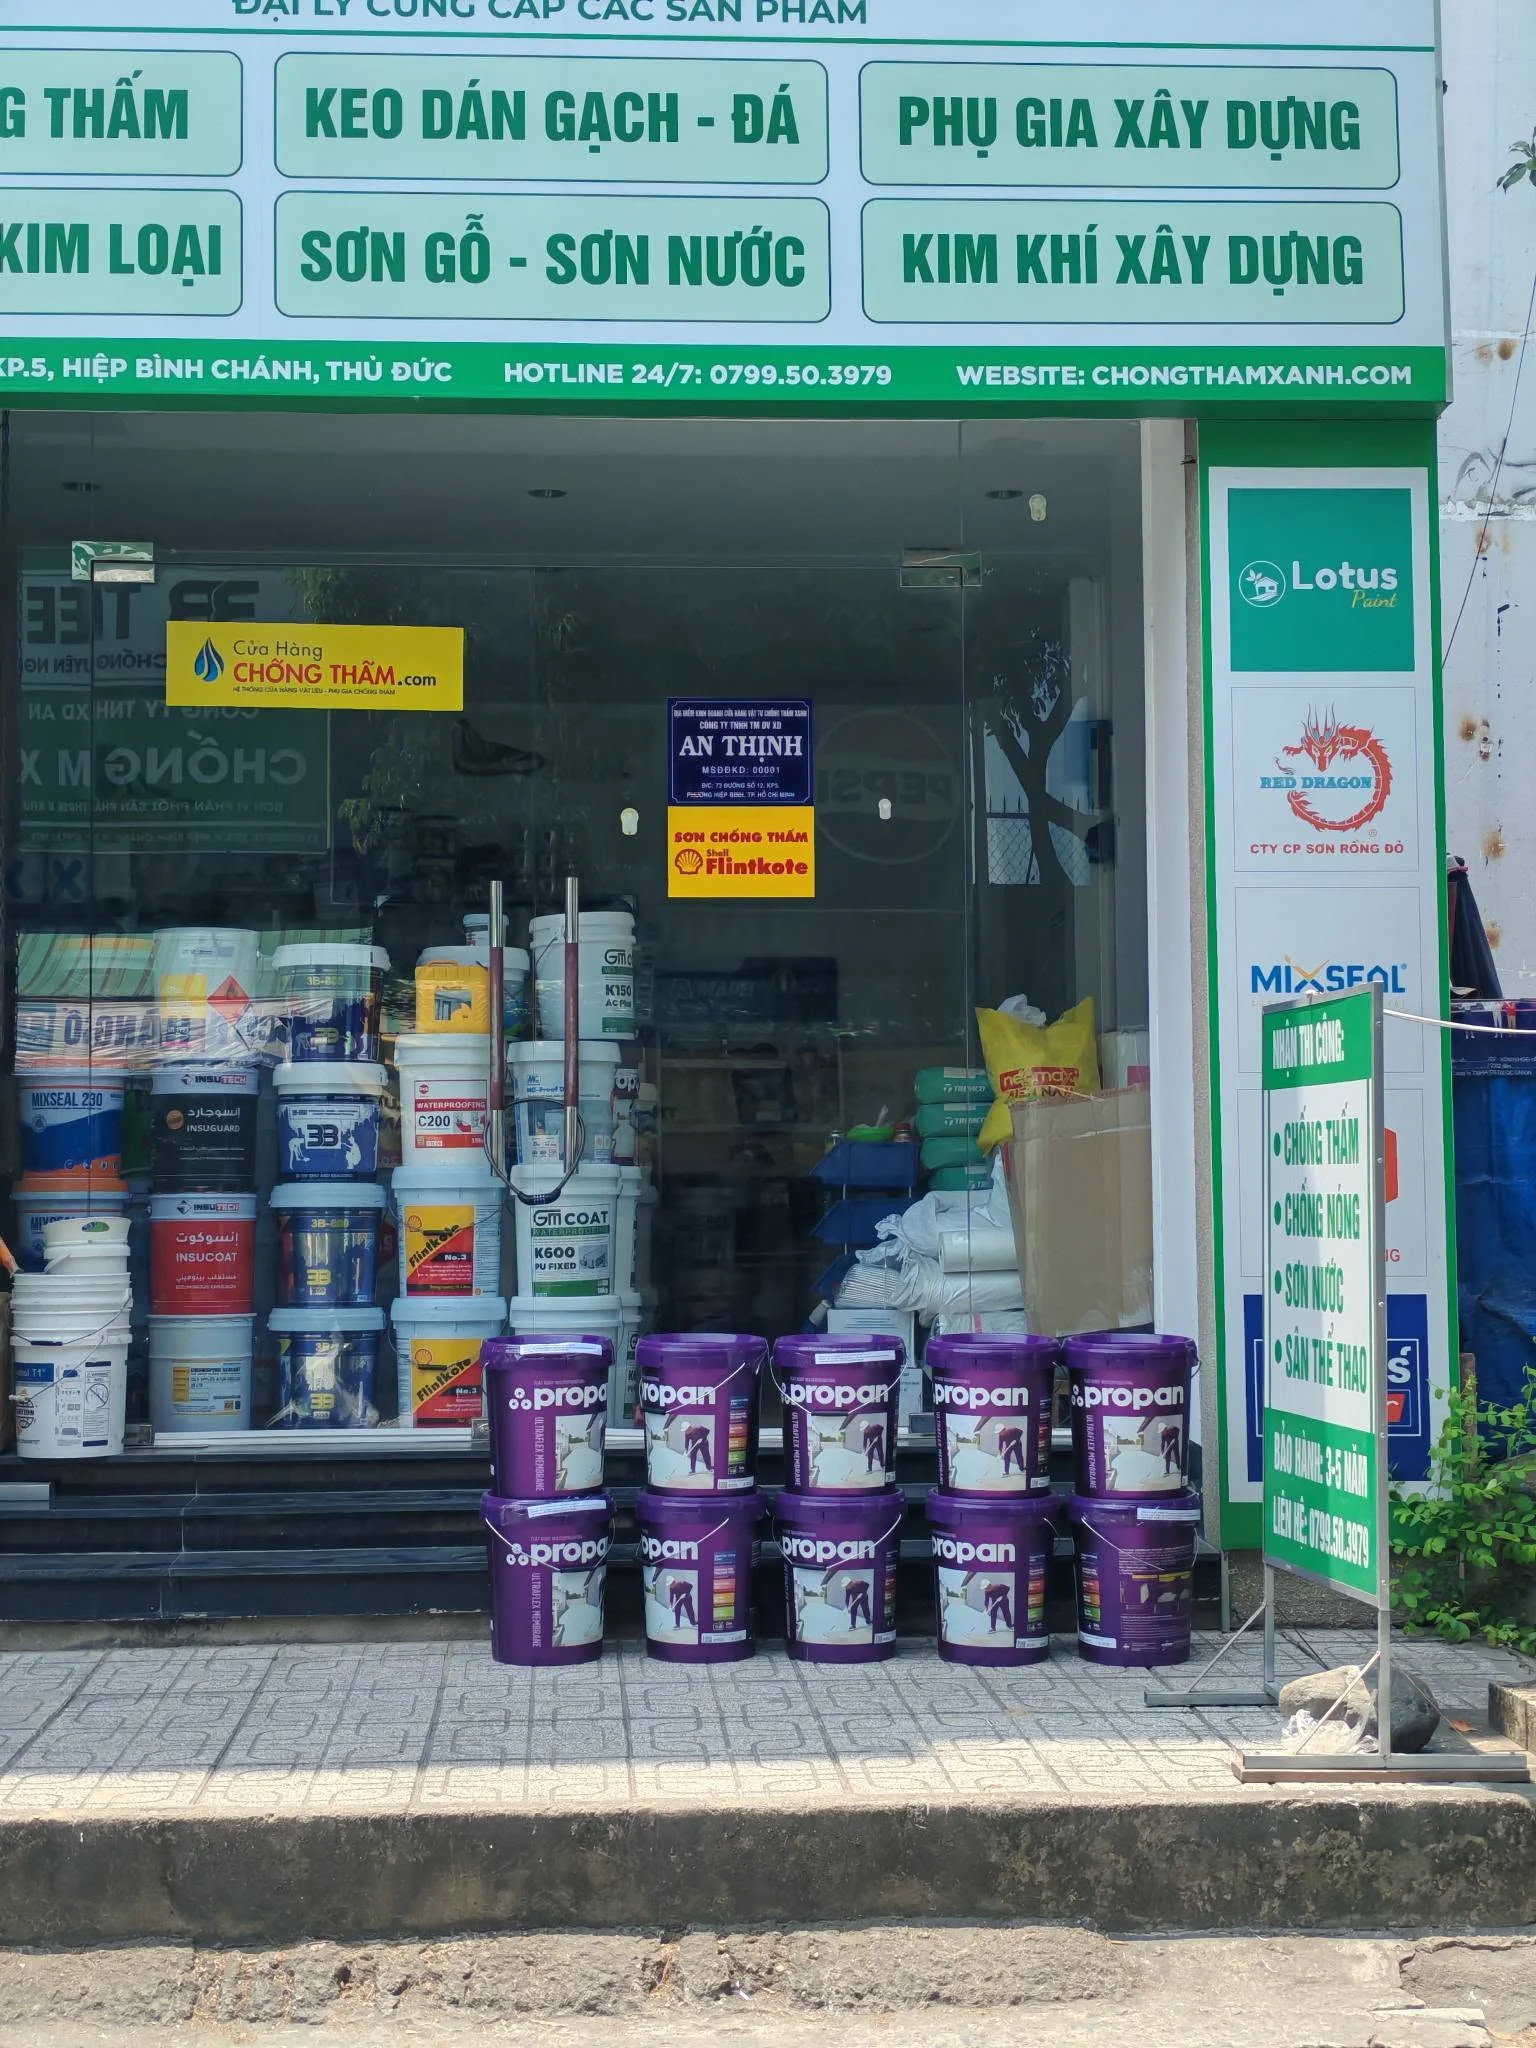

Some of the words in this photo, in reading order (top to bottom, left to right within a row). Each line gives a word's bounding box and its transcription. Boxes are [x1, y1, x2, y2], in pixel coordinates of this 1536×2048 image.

[43, 69, 189, 140] THẤM
[306, 87, 403, 140] KEO
[422, 78, 534, 142] DÁN
[544, 90, 680, 154] GẠCH
[731, 83, 800, 145] ĐÁ
[898, 96, 998, 159] PHỤ
[1015, 98, 1098, 150] GIA
[1114, 88, 1210, 151] XÂY
[1227, 95, 1361, 162] DỰNG
[109, 223, 222, 287] LOẠI
[300, 228, 406, 284] SƠN
[424, 213, 491, 285] GỖ
[545, 229, 649, 286] SƠN
[668, 224, 806, 289] NƯỚC
[902, 233, 998, 285] KIM
[1016, 223, 1099, 285] KHÍ
[1115, 223, 1211, 286] XÂY
[1228, 230, 1364, 296] DỰNG
[63, 353, 128, 384] HIỆP
[136, 354, 204, 380] BÌNH
[211, 354, 319, 384] CHÁNH,
[325, 354, 384, 381] THỦ
[391, 356, 453, 383] ĐỨC
[504, 362, 624, 384] HOTLINE
[631, 363, 702, 388] 24/7:
[709, 363, 892, 386] 0799.50.3979
[956, 365, 1086, 387] WEBSITE:
[1092, 365, 1413, 387] CHONGTHAMXANH.COM
[1293, 560, 1398, 591] Lotus
[1351, 589, 1399, 609] Paint
[232, 639, 270, 657] Cửa
[276, 639, 323, 661] Hàng
[232, 658, 323, 685] CHỐNG
[720, 720, 729, 730] TY
[730, 720, 748, 730] TNHH
[750, 720, 760, 730] TM
[678, 735, 714, 757] AN
[721, 735, 803, 763] THỊNH
[1260, 775, 1297, 790] RED
[1300, 775, 1372, 790] DRAGON
[674, 831, 705, 843] SƠN
[709, 828, 763, 843] CHỐNG
[767, 828, 809, 843] THẤM
[1250, 843, 1277, 854] CTY
[1282, 843, 1301, 854] CP
[1306, 842, 1335, 855] SƠN
[1339, 839, 1380, 854] RỒNG
[706, 848, 729, 857] Shell
[706, 856, 809, 875] Flintkote
[1273, 1018, 1297, 1078] NHẬN
[1299, 1022, 1314, 1066] THI
[1315, 1011, 1344, 1065] CÔNG:
[32, 1092, 78, 1107] MIXSEAL
[417, 1101, 486, 1109] WATERPROOFING
[186, 1124, 241, 1133] INSUGUARD
[418, 1115, 451, 1128] C200
[1284, 1106, 1323, 1166] CHỐNG
[1326, 1102, 1360, 1165] THẤM
[306, 1124, 339, 1147] 3B
[564, 1210, 609, 1226] COAT
[1285, 1177, 1323, 1238] CHỐNG
[1327, 1184, 1360, 1240] NÓNG
[175, 1252, 238, 1263] INSUCOAT
[535, 1246, 576, 1259] K600
[548, 1262, 577, 1271] FIXED
[1285, 1260, 1309, 1309] SƠN
[1312, 1257, 1344, 1314] NƯỚC
[1285, 1325, 1309, 1381] SÂN
[1312, 1322, 1334, 1386] THỂ
[1336, 1343, 1367, 1394] THAO
[790, 1383, 889, 1408] propan
[934, 1383, 1029, 1410] propan
[1084, 1385, 1184, 1411] propan
[1274, 1420, 1293, 1474] BẢO
[1325, 1446, 1342, 1490] 3-5
[1343, 1444, 1368, 1498] NĂM
[1273, 1489, 1292, 1539] LIÊN
[1309, 1508, 1369, 1569] 0799.50.3979
